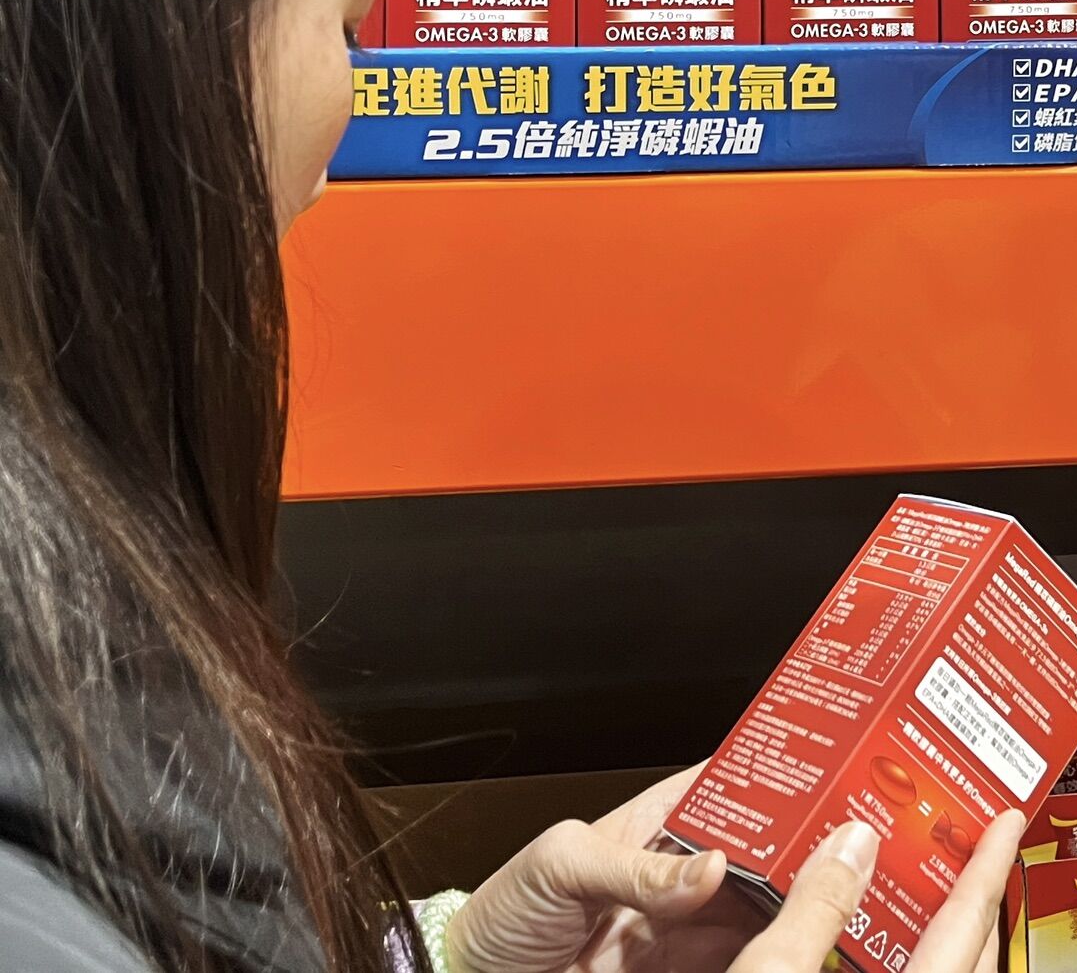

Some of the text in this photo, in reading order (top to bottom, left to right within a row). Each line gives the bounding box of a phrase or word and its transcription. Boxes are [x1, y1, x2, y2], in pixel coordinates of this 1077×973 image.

[832, 8, 874, 18] 750mg
[606, 26, 734, 41] OMEGA-3 軟膠囊
[584, 64, 837, 113] 打造好氣色
[423, 117, 764, 160] 2.5倍純淨磷蝦油
